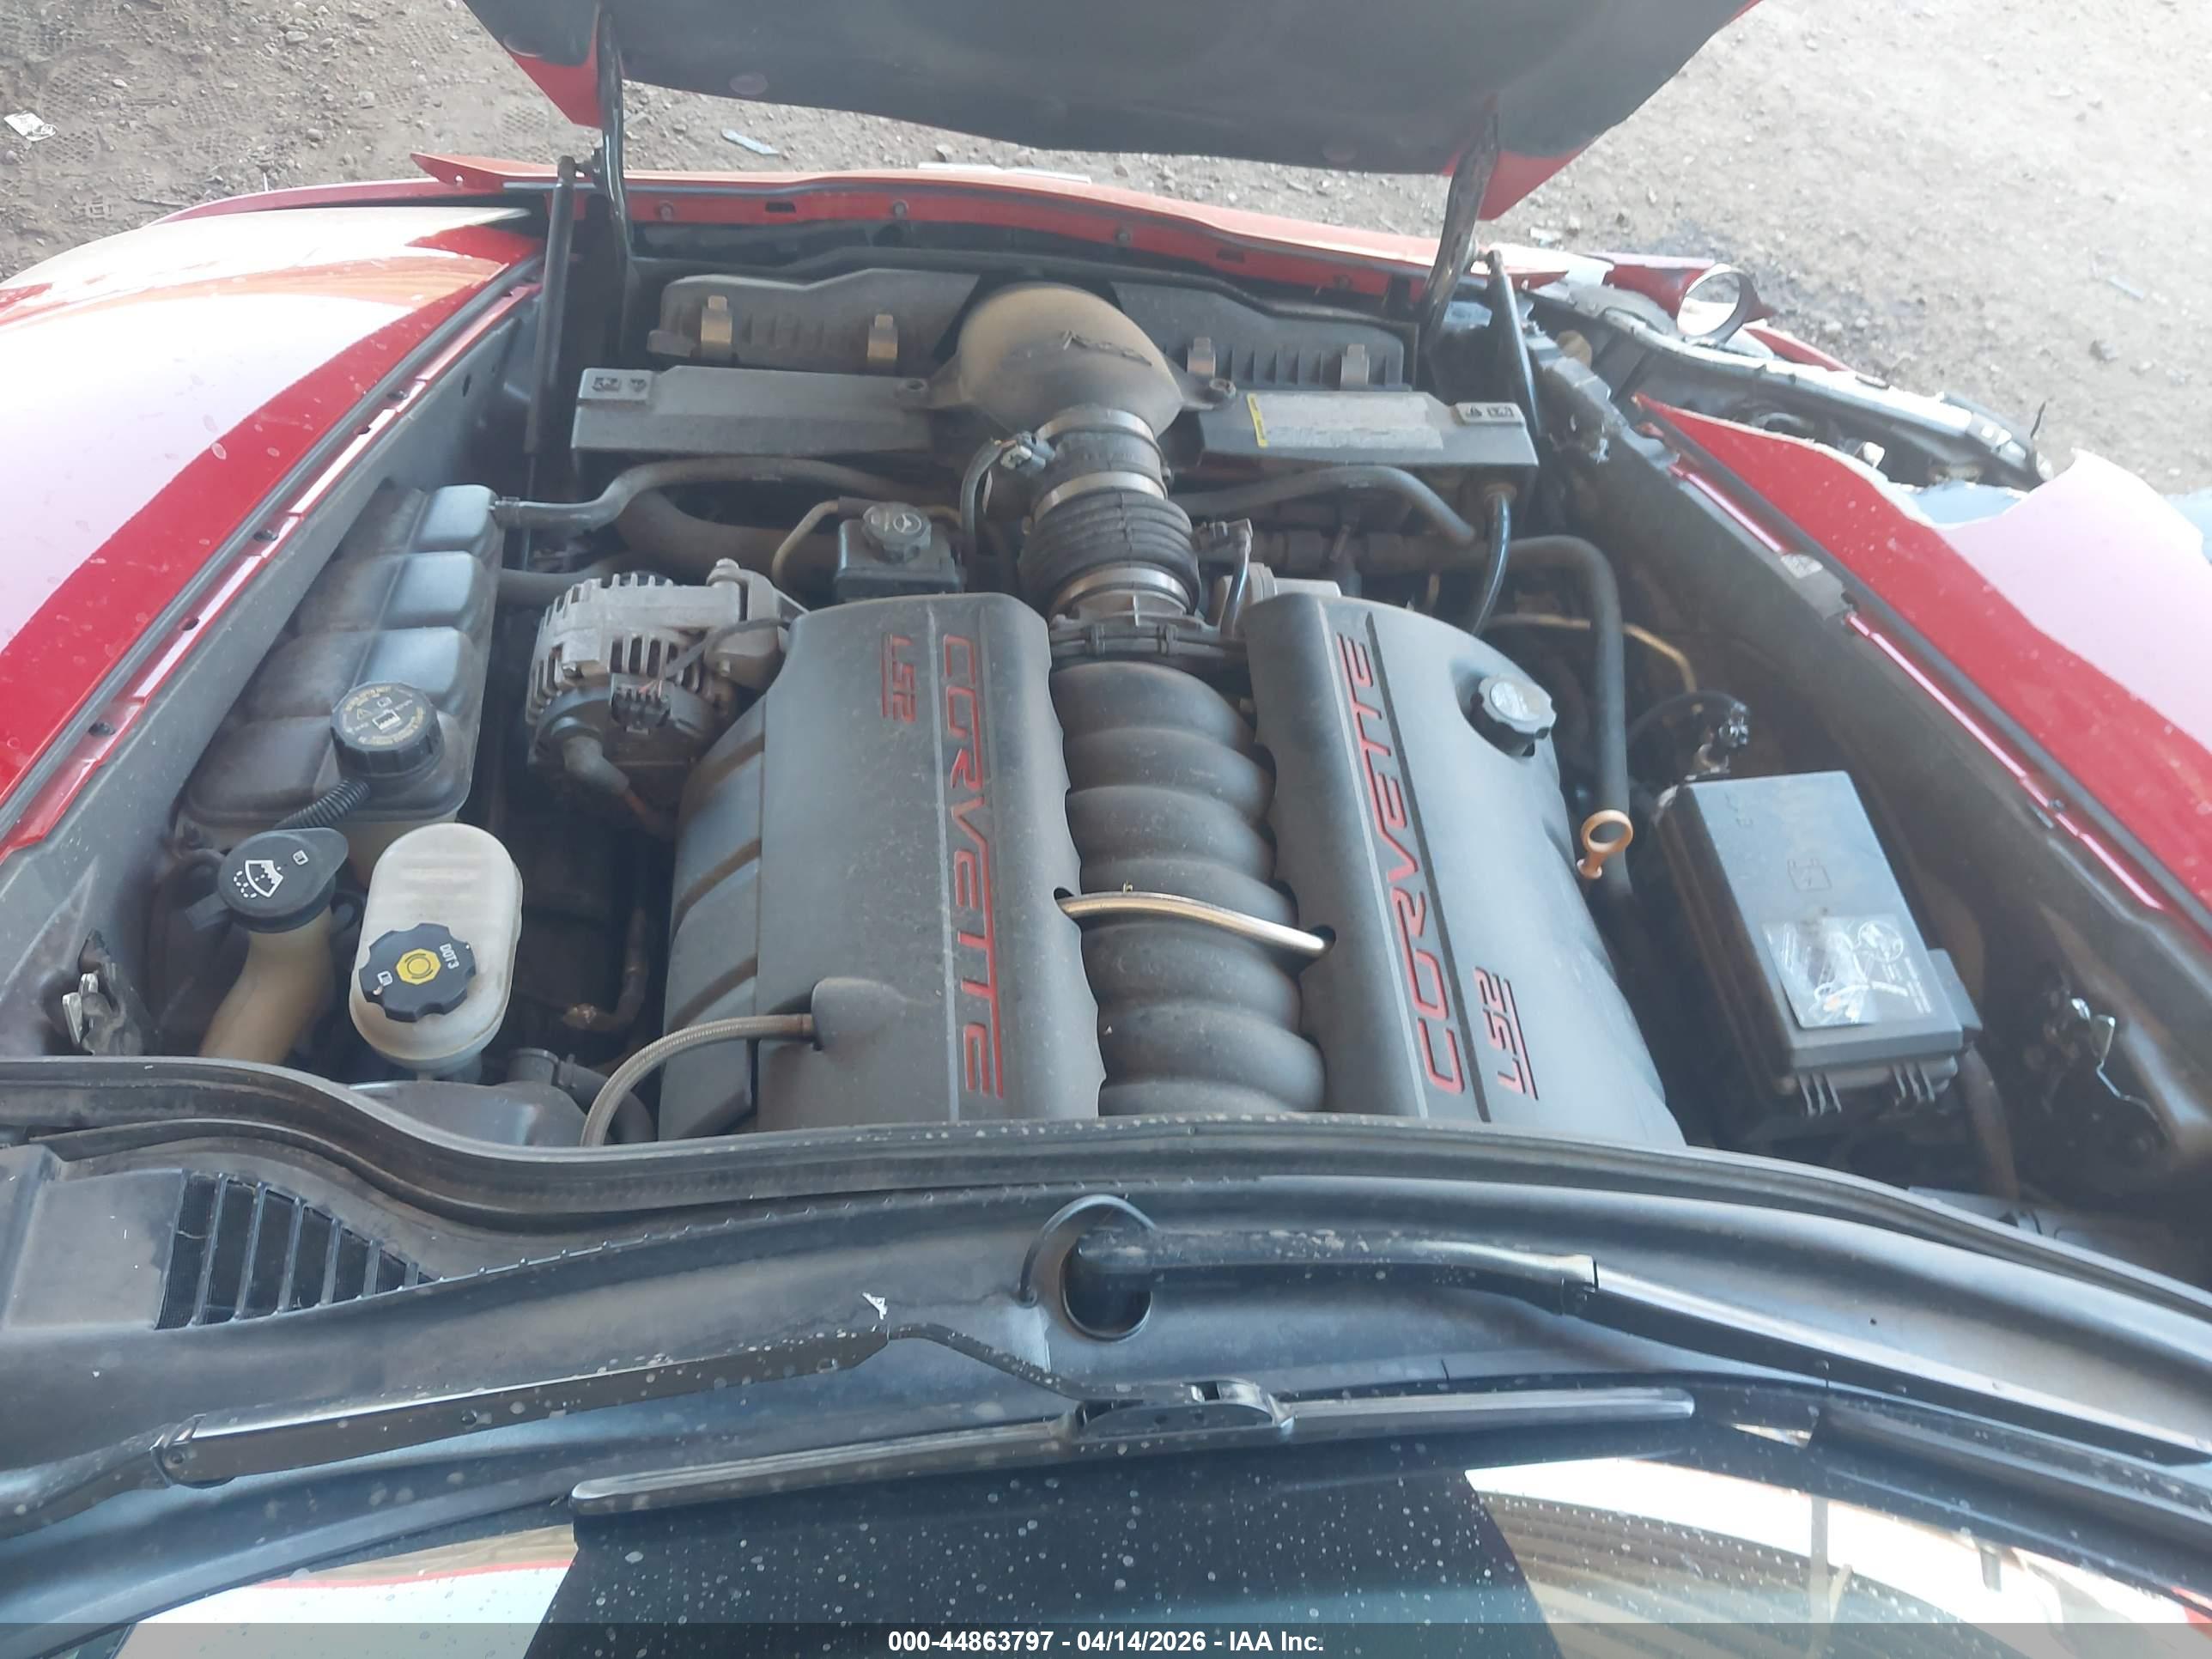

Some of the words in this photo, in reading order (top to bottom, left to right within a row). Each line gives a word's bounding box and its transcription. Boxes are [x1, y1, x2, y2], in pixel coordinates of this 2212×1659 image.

[885, 634, 917, 724] LS2
[942, 632, 1005, 1100] CORVETTE
[1337, 632, 1465, 1095] CORVETTE
[1474, 966, 1532, 1097] LS2
